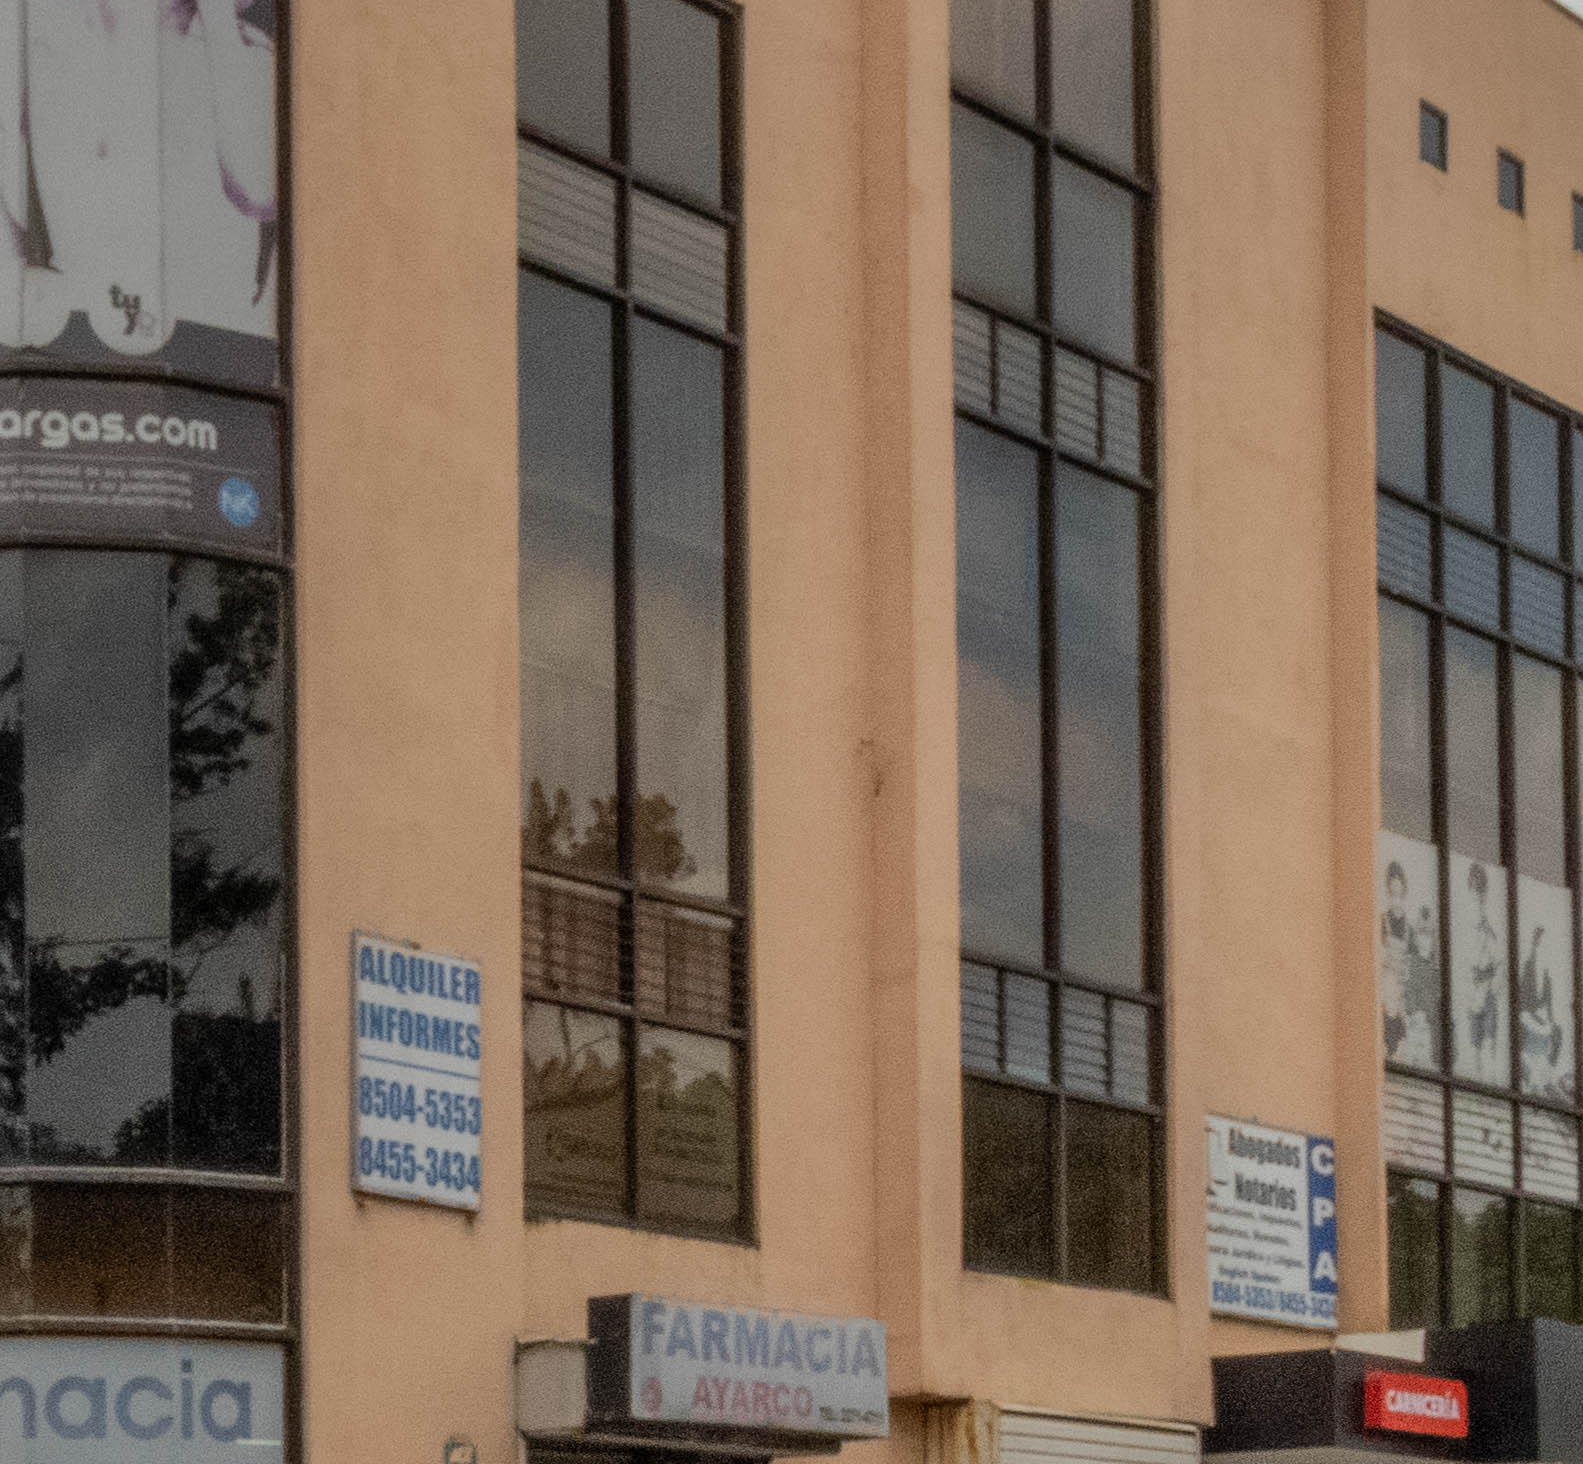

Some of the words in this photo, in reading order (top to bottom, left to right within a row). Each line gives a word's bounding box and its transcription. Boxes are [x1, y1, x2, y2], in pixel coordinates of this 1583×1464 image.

[359, 945, 481, 1005] ALQUILER
[359, 999, 481, 1061] INFORMES
[359, 1075, 482, 1136] 8504-5353
[360, 1136, 482, 1192] 8455-3434
[640, 1301, 883, 1376] FARMACIA
[691, 1375, 815, 1419] AYARCO
